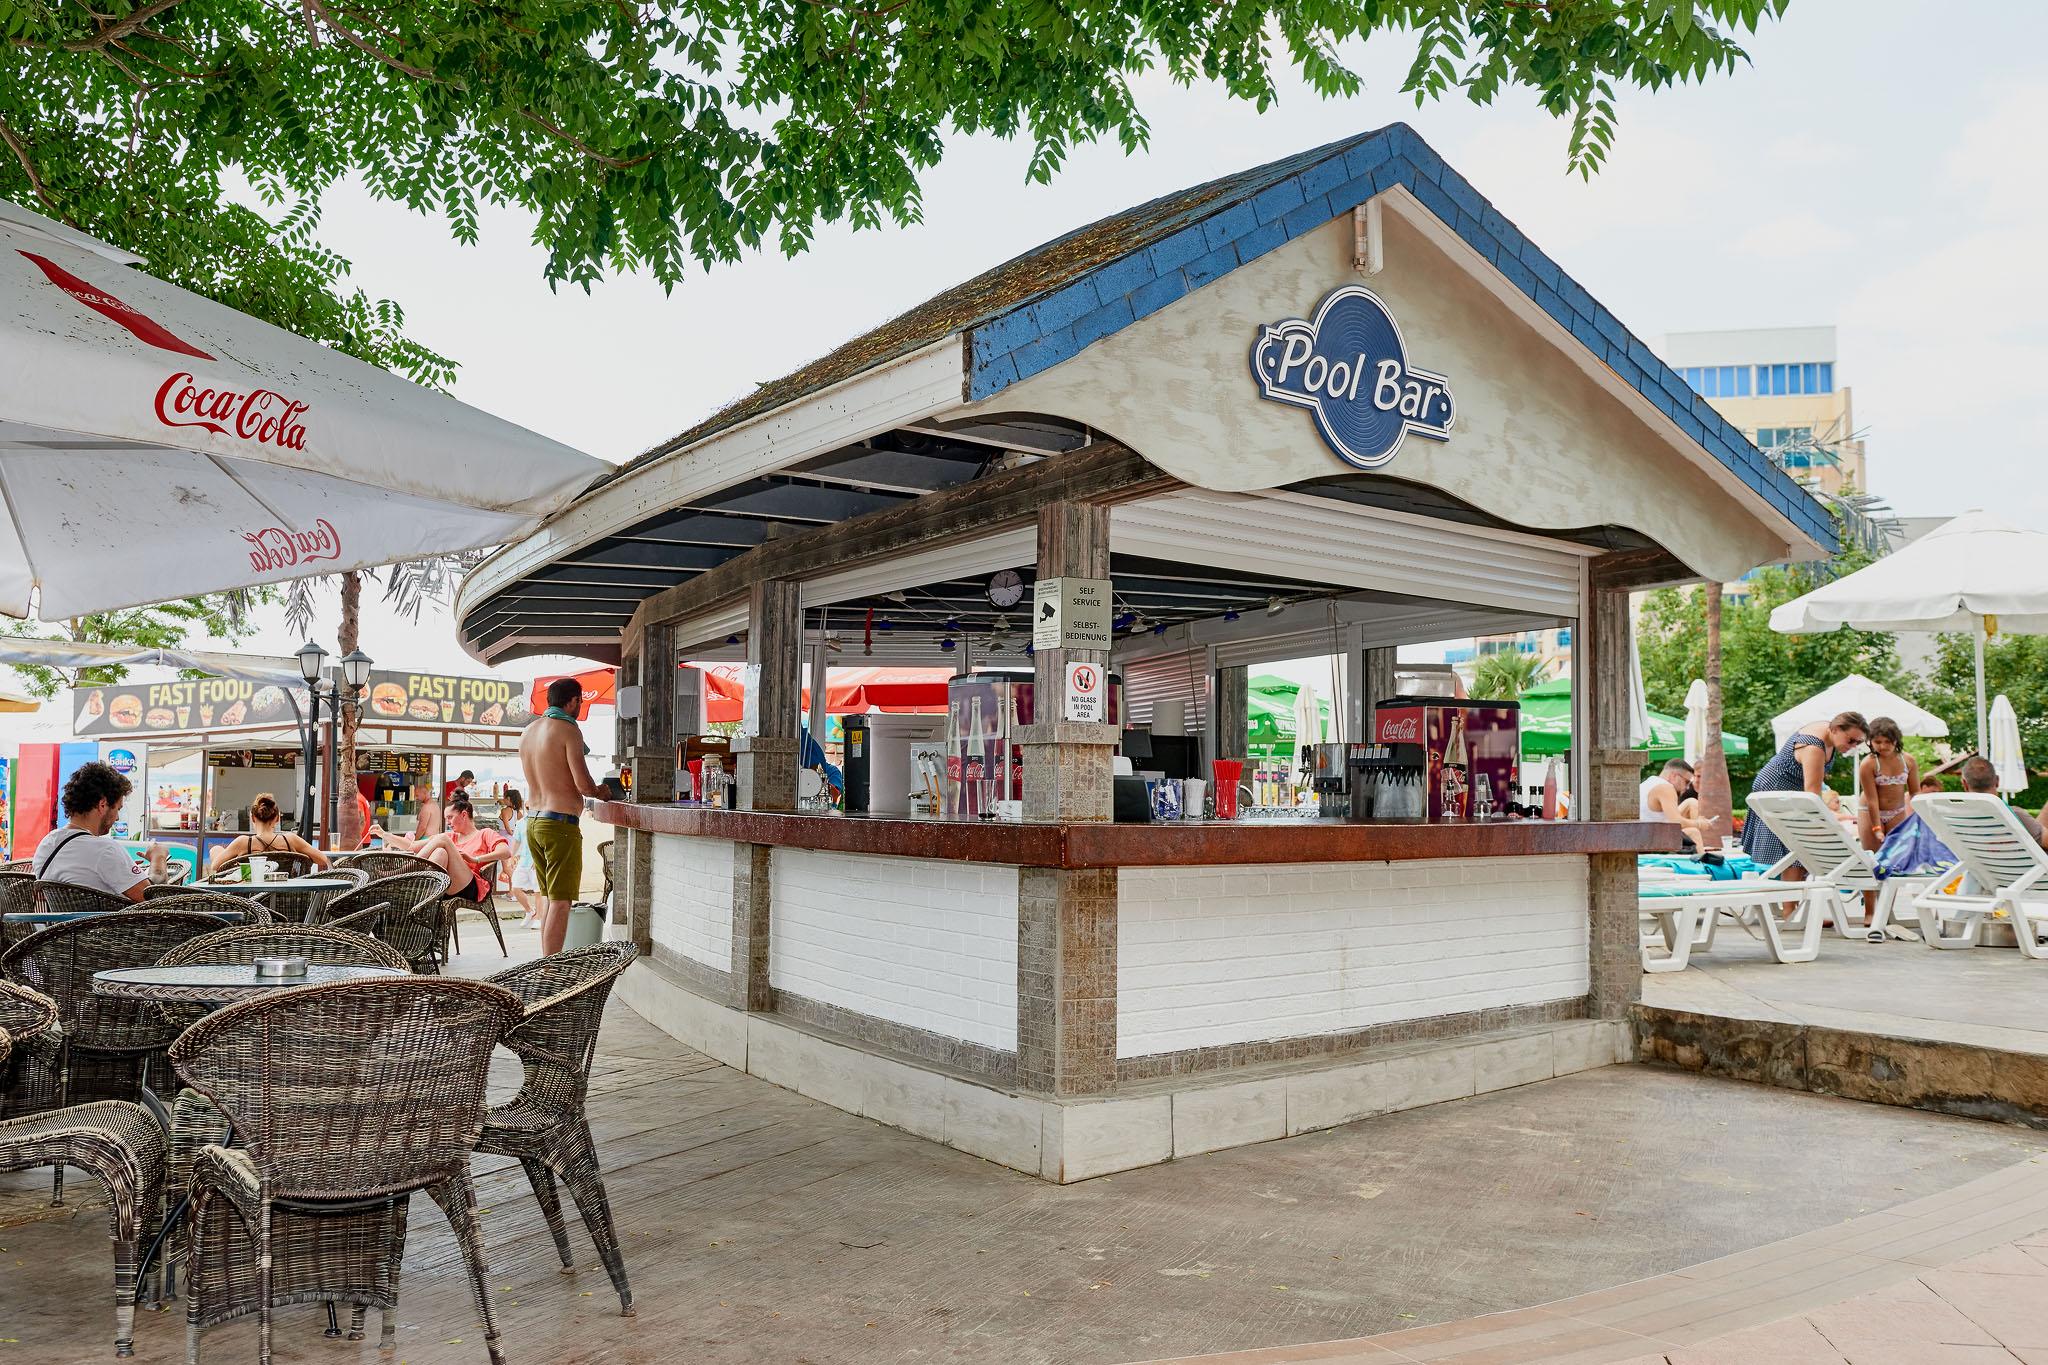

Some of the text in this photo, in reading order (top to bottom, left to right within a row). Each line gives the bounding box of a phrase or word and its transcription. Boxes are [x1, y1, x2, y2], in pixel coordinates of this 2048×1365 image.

[1278, 334, 1442, 419] Pool Bar
[154, 372, 310, 450] Coca-Cola
[1079, 587, 1095, 595] SELF
[1072, 598, 1101, 607] SERVICE
[1073, 621, 1100, 630] SELBST-
[1065, 632, 1107, 642] BEDIENUNG
[149, 679, 253, 707] FAST FOOD
[409, 675, 510, 703] FAST FOOD
[1080, 696, 1097, 704] GLASS
[1076, 711, 1090, 719] AREA
[1382, 717, 1418, 740] Coca-Cola
